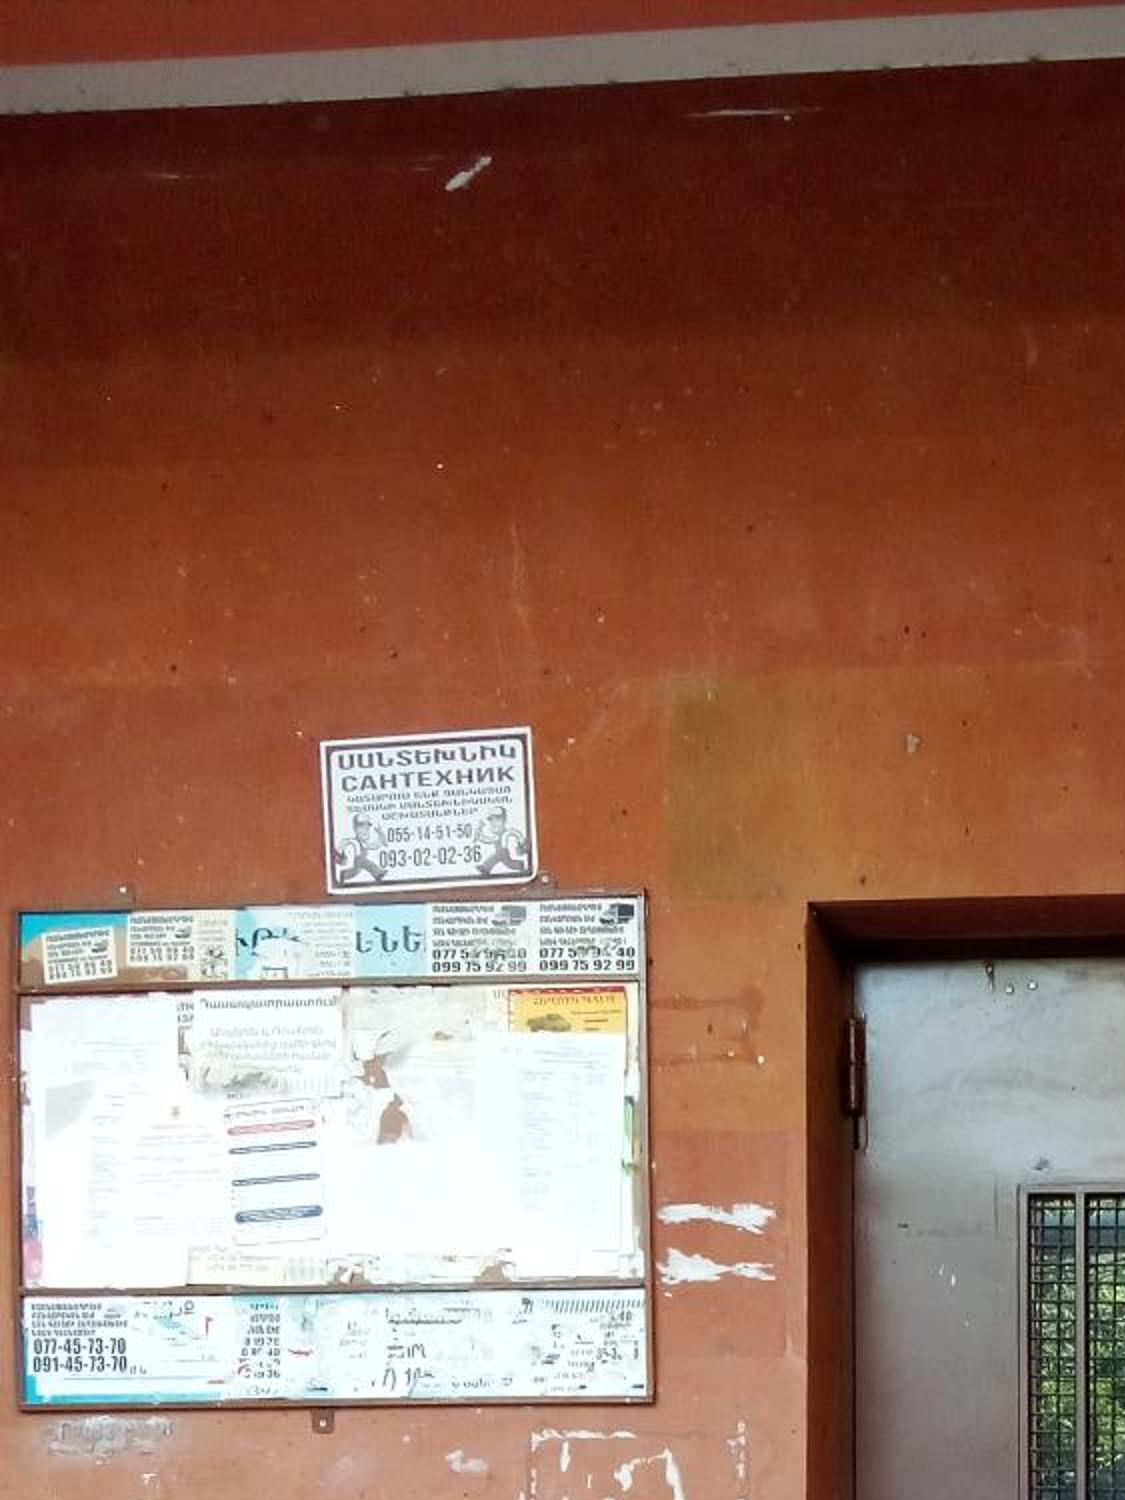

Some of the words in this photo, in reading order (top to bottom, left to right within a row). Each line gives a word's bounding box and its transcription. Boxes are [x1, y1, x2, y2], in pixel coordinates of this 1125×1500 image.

[338, 745, 517, 770] ՍԱՆՏԵԽՆԻԿ
[341, 766, 515, 792] САНТЕХНИК
[387, 824, 473, 843] 055-14-51-50
[379, 846, 482, 868] 093-02-02-36
[540, 959, 568, 971] 099
[593, 959, 611, 971] 92
[615, 959, 635, 971] 99
[33, 1337, 127, 1355] 077-45-73-70
[33, 1356, 128, 1373] 091-45-73-70
